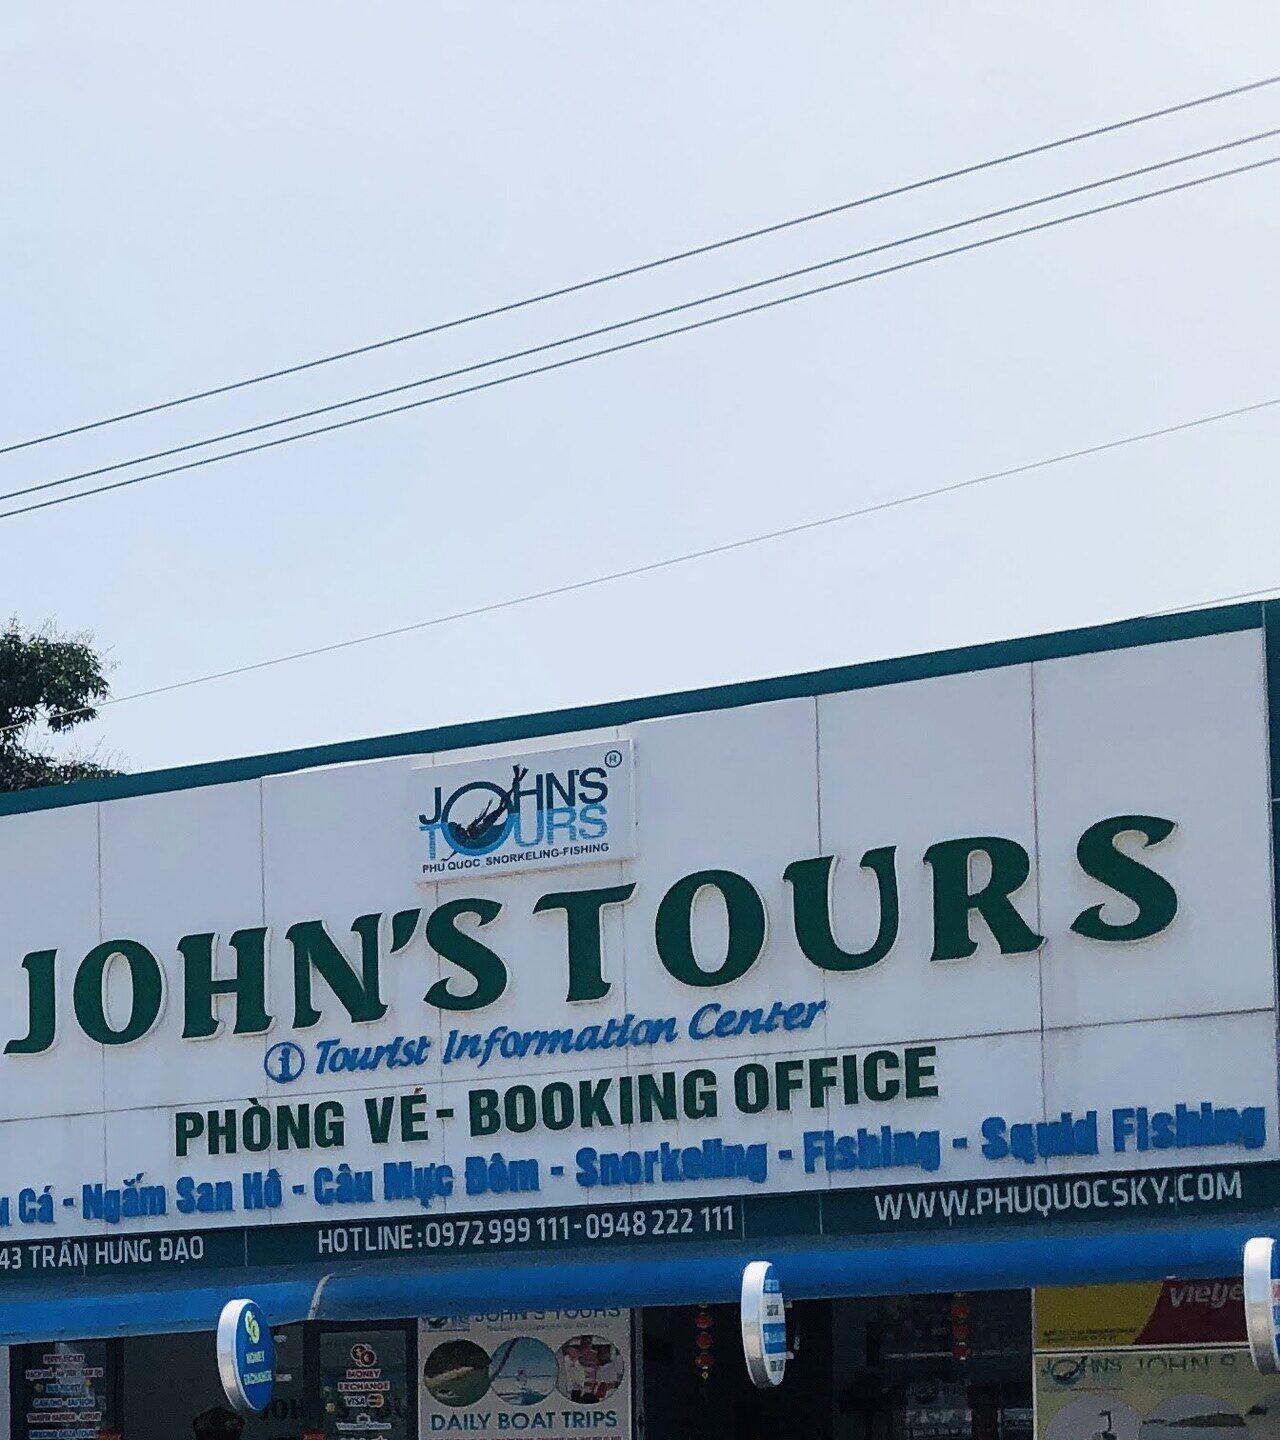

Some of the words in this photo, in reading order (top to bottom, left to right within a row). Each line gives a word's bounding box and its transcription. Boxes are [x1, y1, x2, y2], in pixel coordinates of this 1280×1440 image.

[4, 898, 508, 1056] JOHN'S
[532, 813, 1179, 1003] TOURS
[315, 1035, 431, 1075] Tourist
[442, 1013, 678, 1068] Information
[688, 998, 828, 1042] Center
[175, 1097, 345, 1157] PHÒNG
[467, 1068, 718, 1137] BOOKING
[733, 1045, 939, 1115] OFFICE
[18, 1185, 55, 1224] Cá
[82, 1172, 167, 1224] Ngắm
[176, 1176, 234, 1214] San
[313, 1162, 373, 1206] Câu
[575, 1137, 768, 1187] Snorkeling
[803, 1125, 940, 1174] Fishing
[981, 1111, 1099, 1164] Squid
[1112, 1102, 1268, 1154] Fishing
[95, 1237, 152, 1266] HƯNG
[159, 1235, 204, 1266] ĐẠO
[1169, 1282, 1245, 1309] vietje
[339, 1381, 389, 1391] EXCHANGE
[430, 1412, 492, 1431] DAILY
[497, 1411, 556, 1430] BOAT
[561, 1410, 618, 1429] TRIPS
